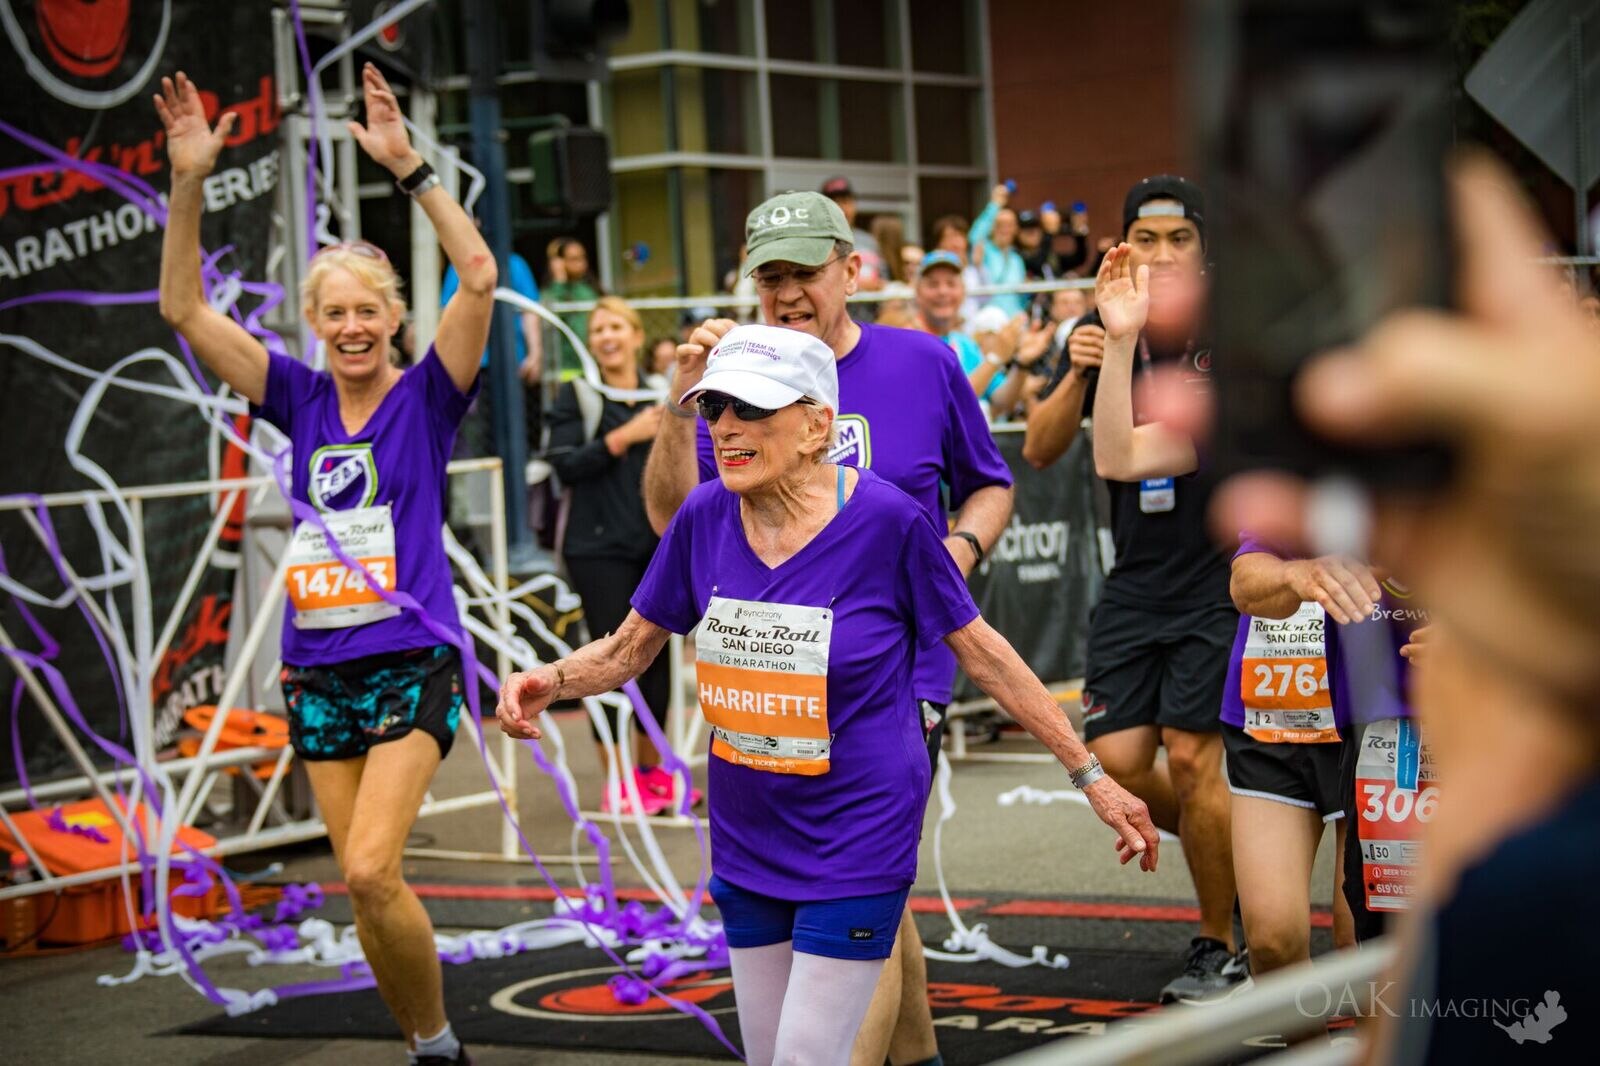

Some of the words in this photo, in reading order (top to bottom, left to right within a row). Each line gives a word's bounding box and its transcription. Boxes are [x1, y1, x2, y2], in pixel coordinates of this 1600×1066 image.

[748, 342, 767, 350] TEAM
[743, 608, 782, 620] synchrony
[1266, 633, 1286, 643] SAN
[721, 637, 746, 651] SAN
[750, 641, 794, 656] DIEGO
[1274, 648, 1326, 656] MARATHO
[719, 654, 731, 664] 1/2
[733, 657, 796, 671] MARATHON
[700, 682, 821, 719] HARRIETTE
[1264, 714, 1272, 724] 2
[1375, 847, 1389, 858] 30
